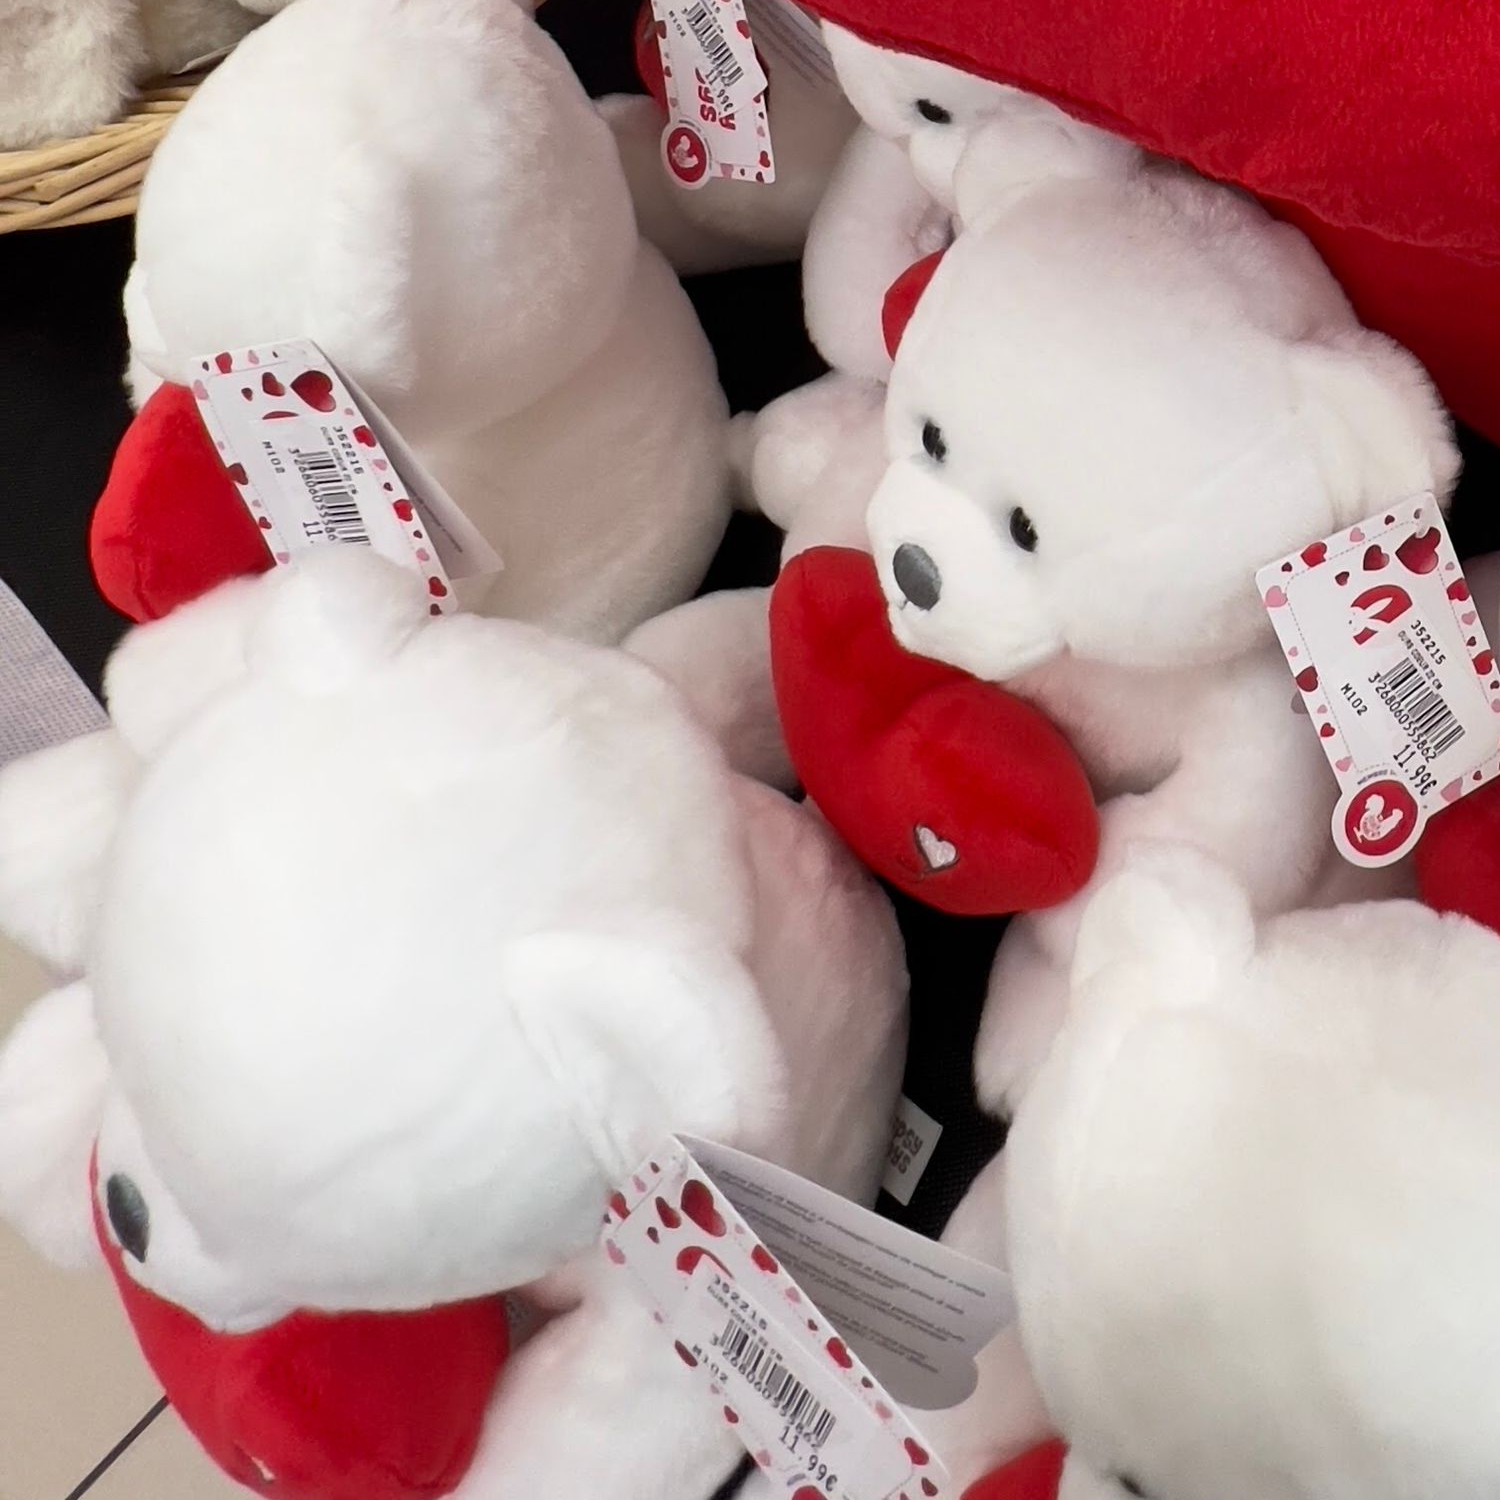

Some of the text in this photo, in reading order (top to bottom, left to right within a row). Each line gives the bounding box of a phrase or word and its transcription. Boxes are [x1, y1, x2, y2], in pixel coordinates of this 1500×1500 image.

[1410, 619, 1446, 665] 352215
[1340, 682, 1368, 717] M102
[1392, 743, 1438, 797] 11.99€
[777, 1424, 839, 1493] 11.99€
